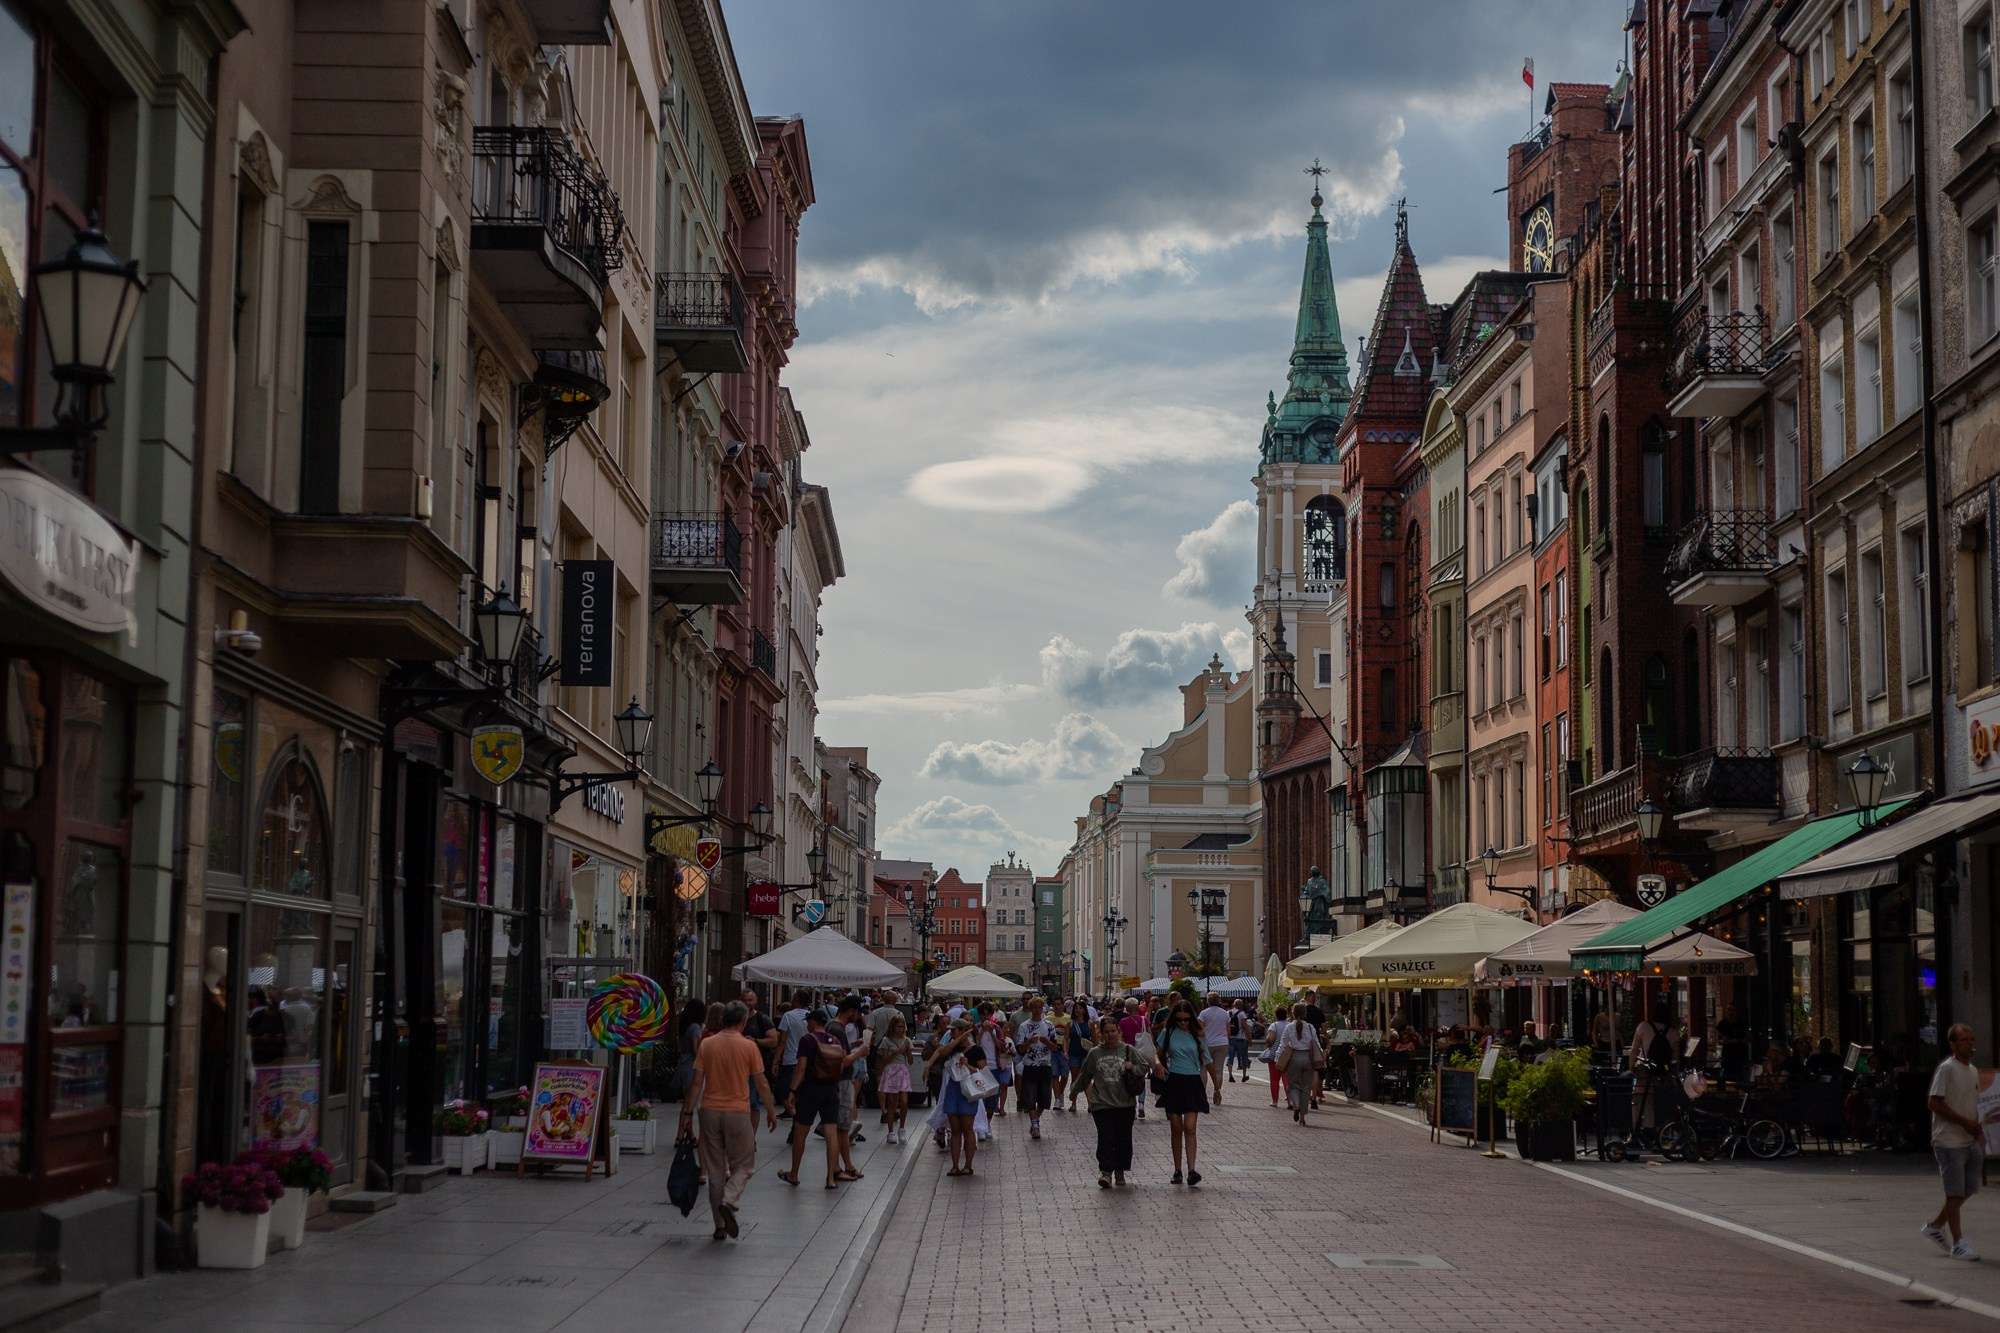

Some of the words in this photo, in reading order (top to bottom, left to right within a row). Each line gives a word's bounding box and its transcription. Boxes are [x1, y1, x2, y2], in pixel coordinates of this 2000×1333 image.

[755, 893, 778, 903] hebe
[1382, 959, 1435, 973] KSIĄŻĘCE
[1516, 964, 1544, 973] BAZA
[1723, 962, 1745, 974] BEAR
[799, 973, 829, 981] KAISER
[550, 1082, 586, 1091] cukierków
